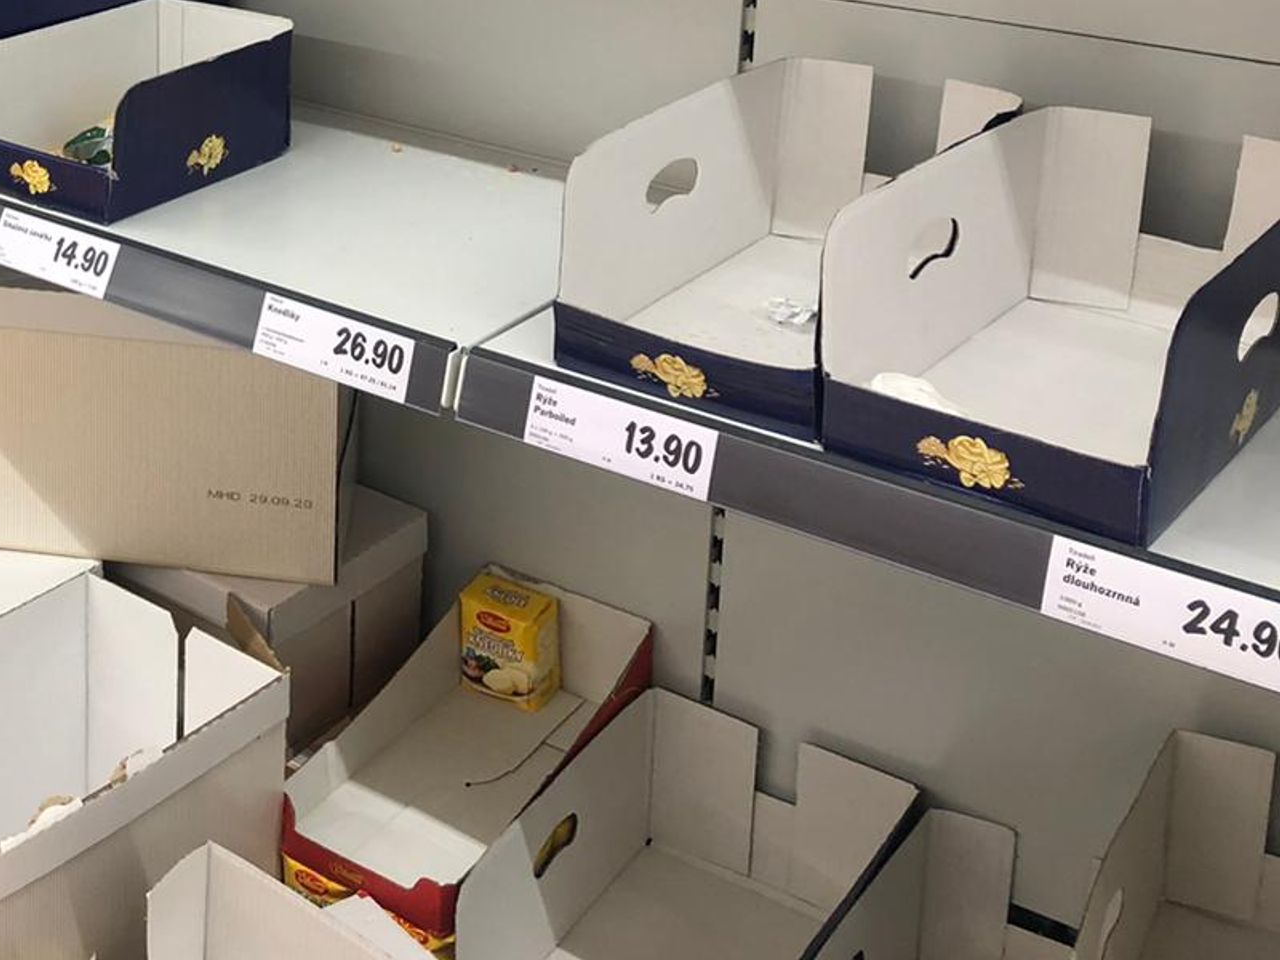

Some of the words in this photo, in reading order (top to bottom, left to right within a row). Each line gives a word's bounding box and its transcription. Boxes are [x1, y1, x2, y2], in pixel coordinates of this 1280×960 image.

[53, 237, 109, 277] 14.90
[333, 327, 405, 375] 26.90
[534, 405, 577, 427] Parboiled
[625, 421, 703, 475] 13.90
[1065, 557, 1098, 577] Rýže
[1062, 573, 1141, 607] dlouhozrnná
[1182, 599, 1280, 660] 24.9
